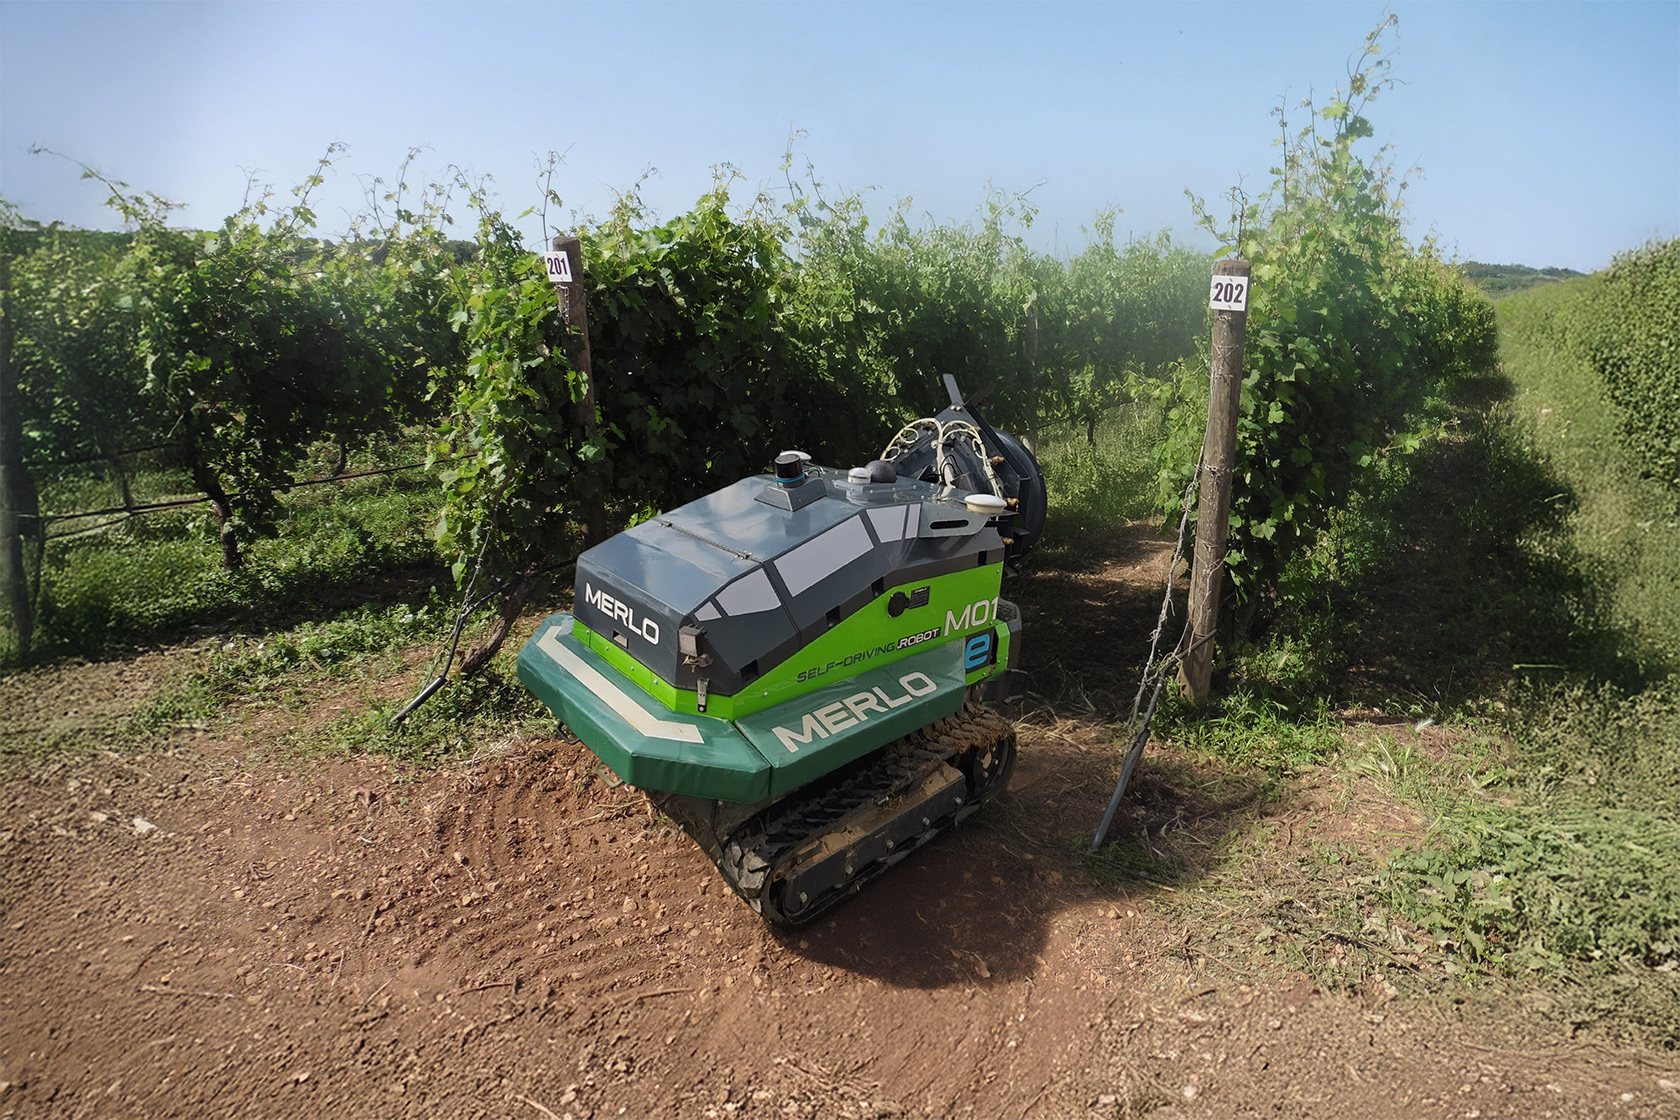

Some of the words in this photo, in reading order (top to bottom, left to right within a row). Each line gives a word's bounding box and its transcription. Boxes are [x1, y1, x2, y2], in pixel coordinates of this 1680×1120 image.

[547, 257, 568, 275] 201
[1212, 282, 1244, 304] 202
[585, 582, 660, 645] MERLO
[965, 633, 991, 670] e
[771, 671, 938, 754] MERLO
